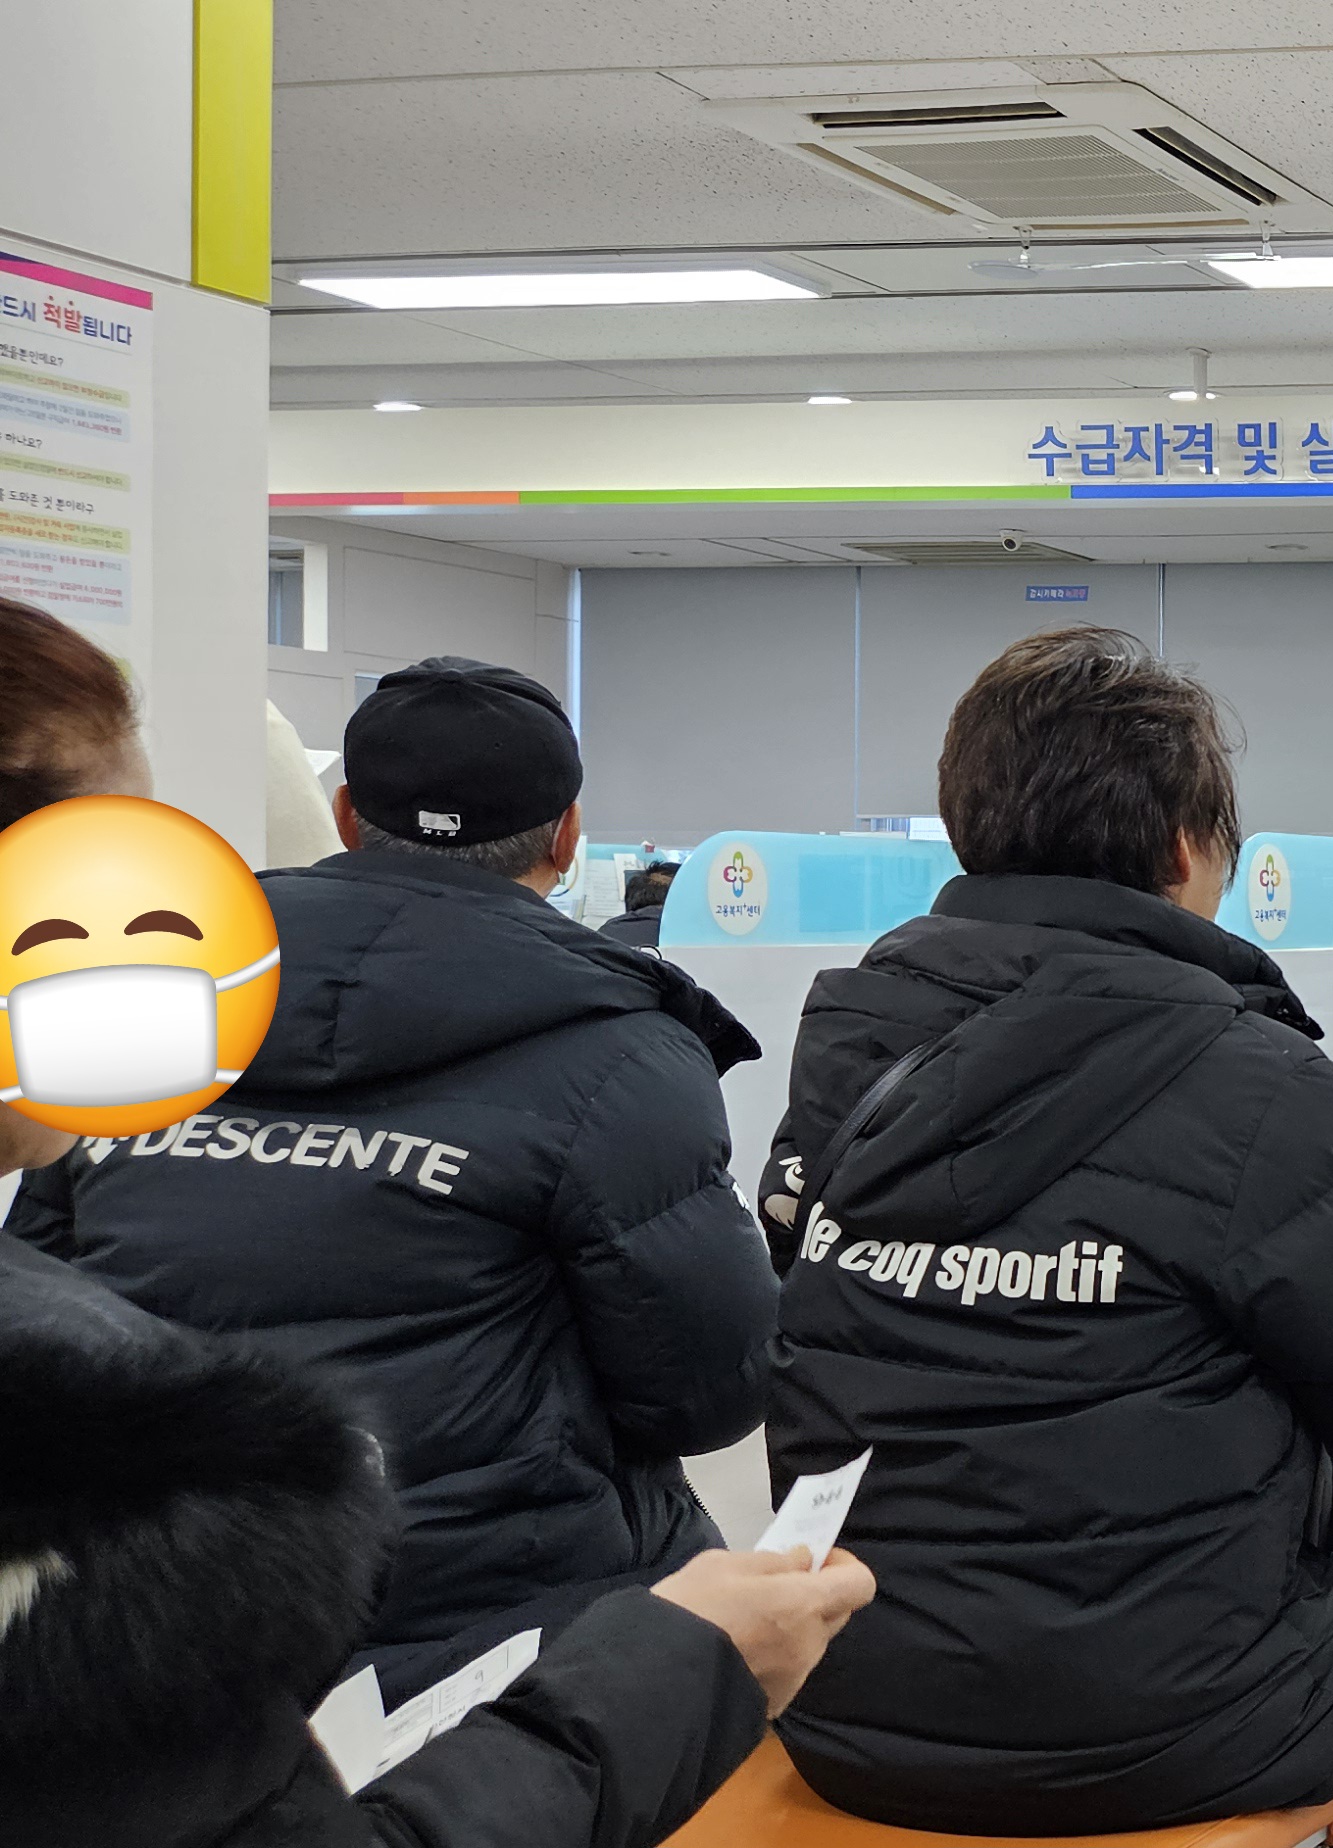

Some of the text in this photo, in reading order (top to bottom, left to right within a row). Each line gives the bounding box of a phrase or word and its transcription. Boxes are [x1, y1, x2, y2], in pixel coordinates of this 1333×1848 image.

[0, 294, 133, 346] 드시 적발됩니다
[1028, 422, 1214, 478] 수급자격
[1237, 421, 1281, 477] 및
[130, 1114, 470, 1196] DESCENTE
[800, 1201, 1124, 1306] le coq sportif
